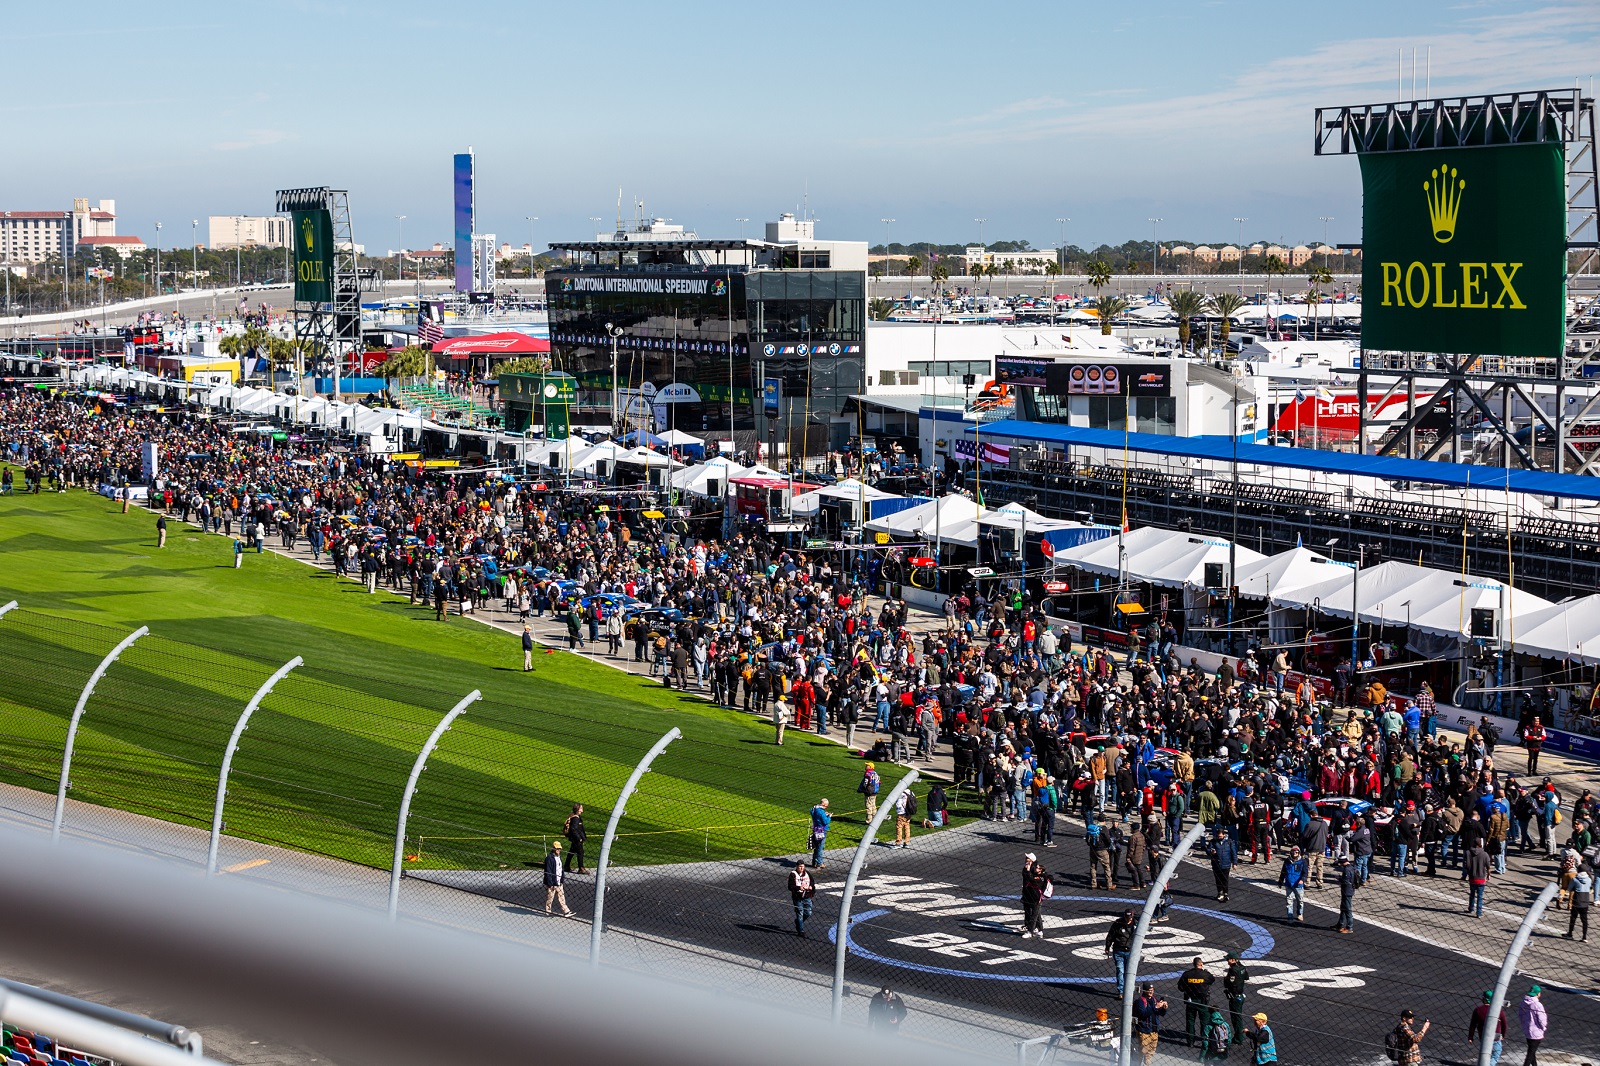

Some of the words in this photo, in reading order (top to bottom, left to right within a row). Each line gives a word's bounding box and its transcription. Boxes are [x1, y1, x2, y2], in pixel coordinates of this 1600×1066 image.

[574, 278, 604, 292] DAYTONA
[605, 278, 663, 293] INTERNATIONAL
[665, 279, 708, 294] SPEEDWAY
[1380, 260, 1527, 310] ROLEX
[887, 932, 1058, 966] BET
